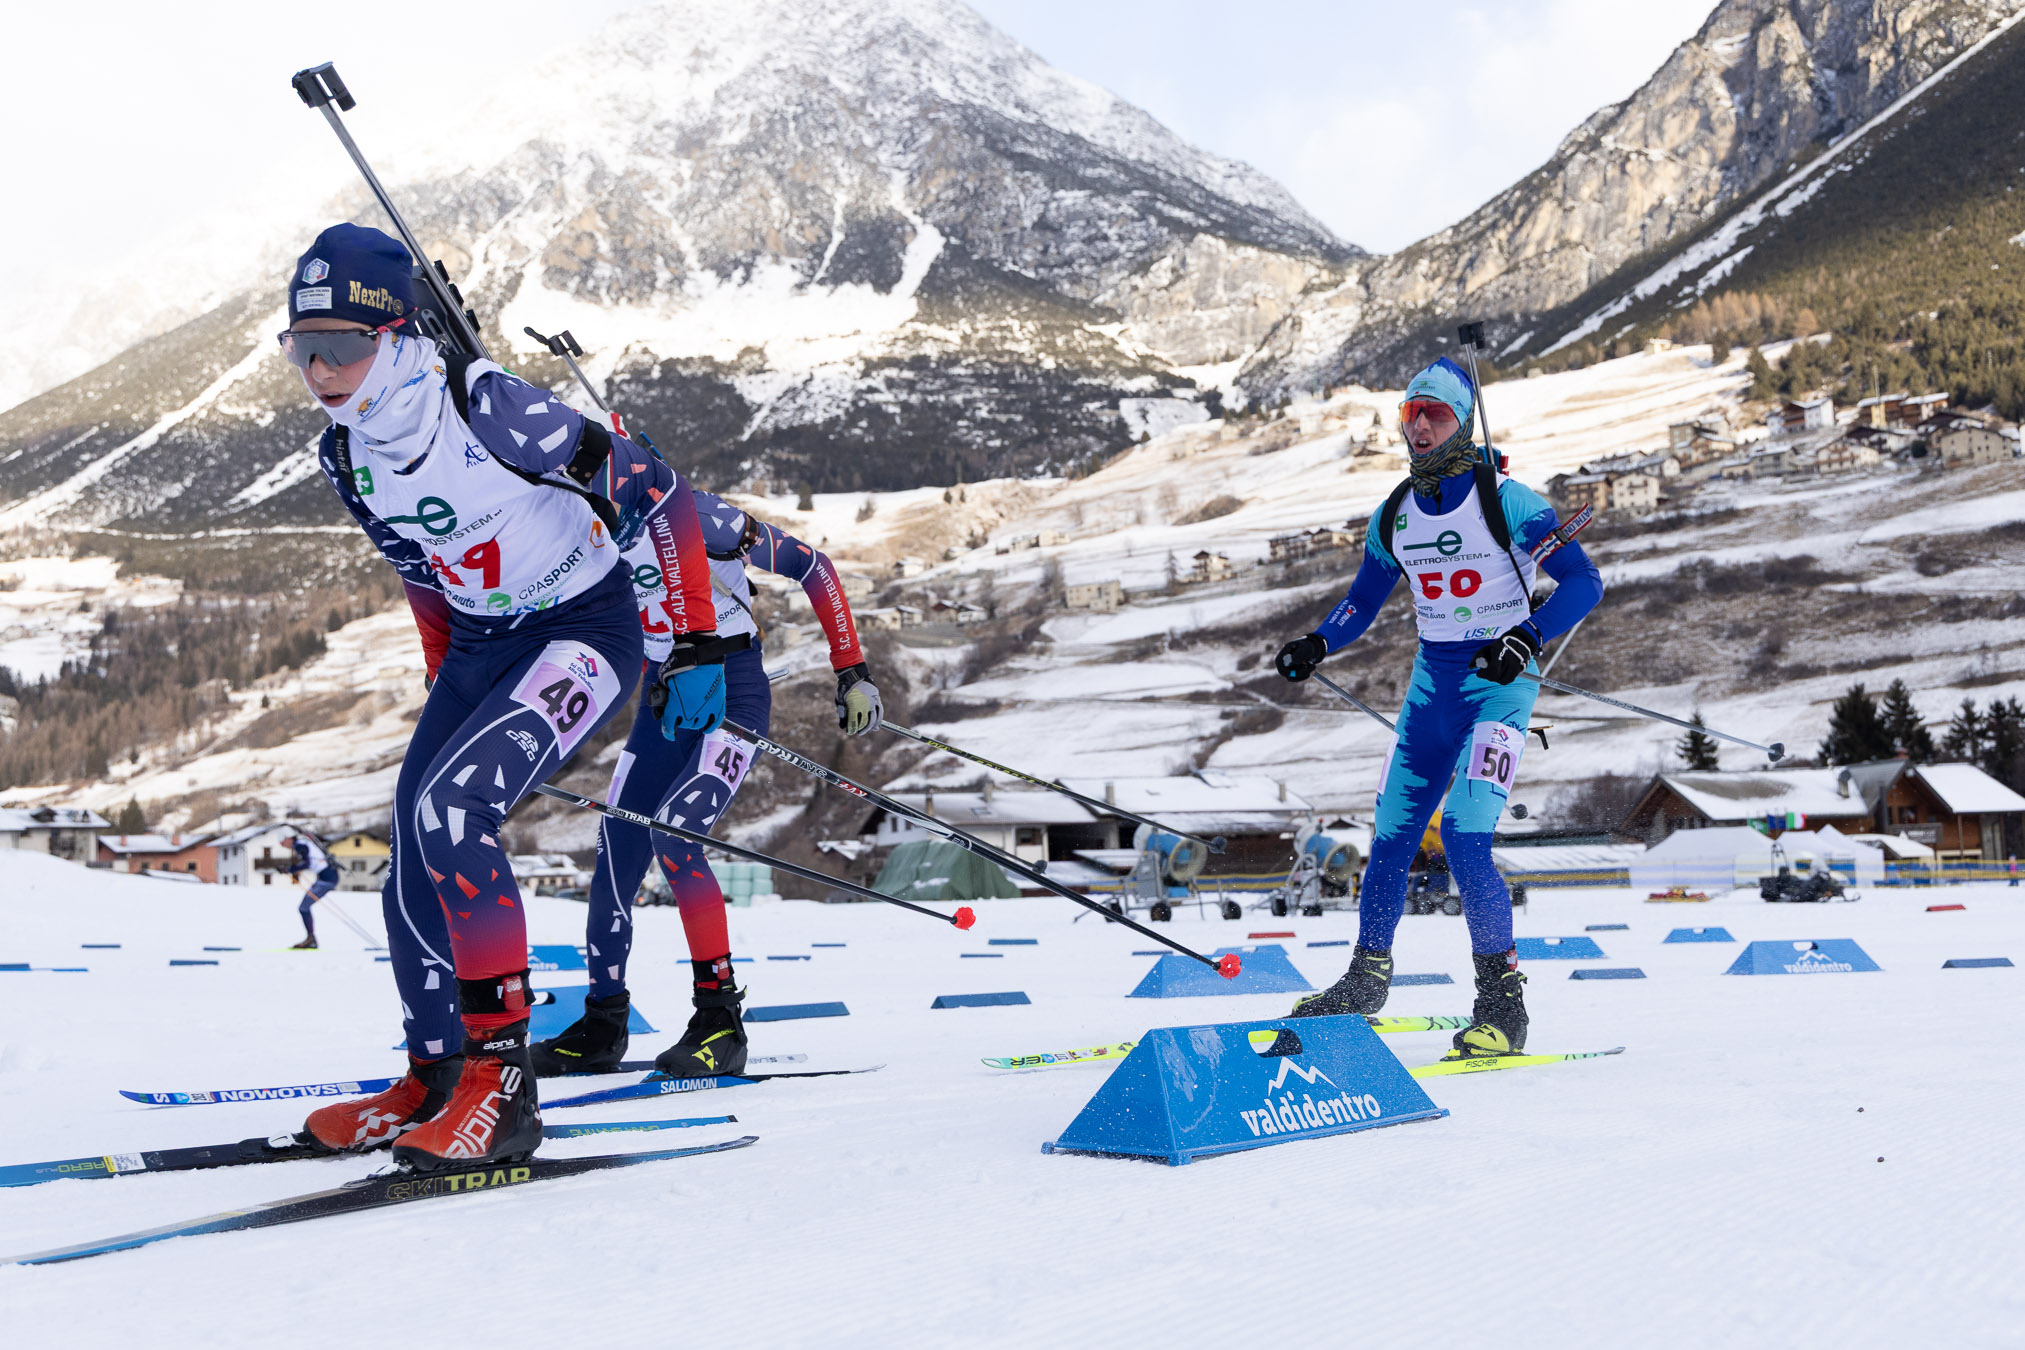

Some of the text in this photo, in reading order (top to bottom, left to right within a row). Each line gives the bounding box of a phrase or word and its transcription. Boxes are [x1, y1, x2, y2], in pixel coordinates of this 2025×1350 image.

[653, 513, 683, 588] VALTELLINA
[1405, 553, 1483, 567] ELETTROSYSTEM
[518, 546, 584, 601] CPASPORT
[1417, 568, 1483, 600] 50
[816, 562, 843, 612] VALTELLINA
[670, 588, 687, 616] ALTA
[1477, 599, 1524, 615] CPASPORT
[835, 611, 849, 633] ALTA
[1464, 626, 1500, 639] LISKI
[538, 677, 589, 734] 49
[714, 745, 745, 785] 45
[754, 739, 828, 779] SKITRAB
[1481, 747, 1511, 784] 50
[1784, 957, 1853, 974] valdidentro
[483, 1037, 515, 1051] alpina
[1465, 1058, 1498, 1068] FISCHER
[219, 1082, 339, 1102] SALOMON
[660, 1077, 718, 1093] SALOMON
[1240, 1091, 1382, 1137] valdidentro
[58, 1157, 105, 1173] AERO
